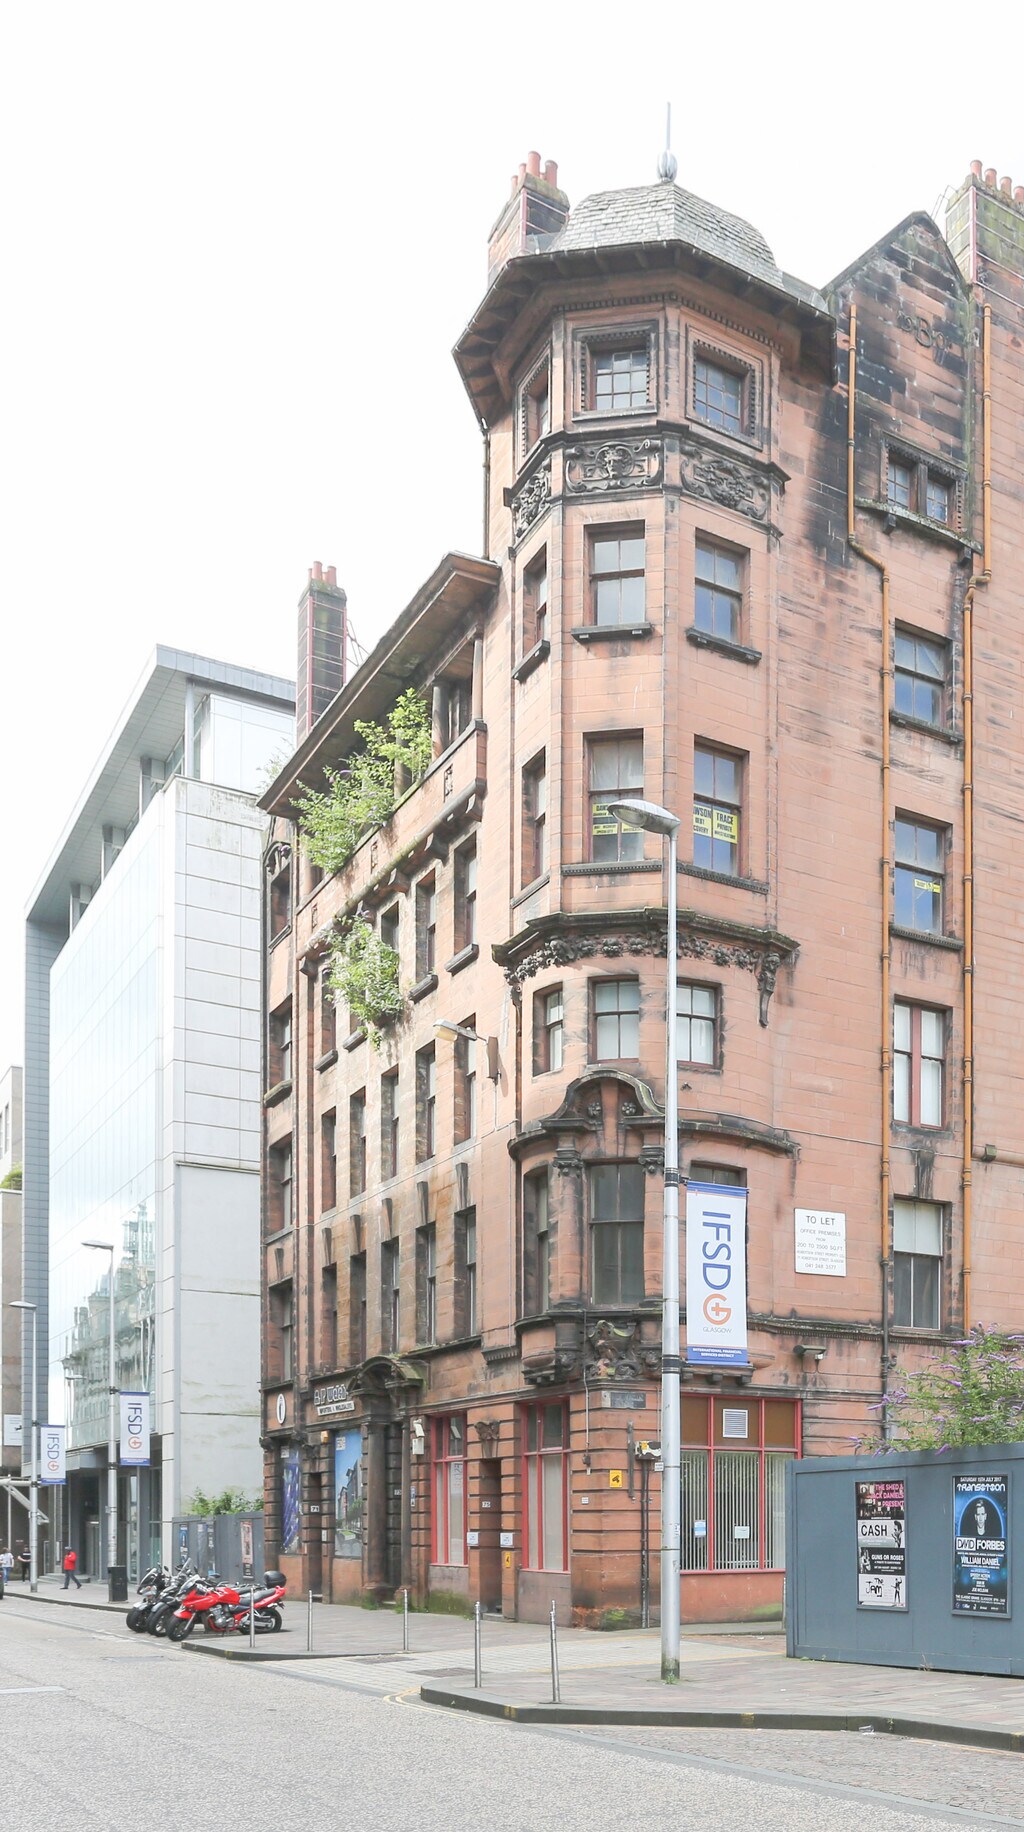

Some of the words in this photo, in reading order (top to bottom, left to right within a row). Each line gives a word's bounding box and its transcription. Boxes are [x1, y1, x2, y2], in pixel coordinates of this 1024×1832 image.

[716, 812, 734, 825] TRACE
[805, 1215, 817, 1225] TO
[820, 1217, 836, 1226] LET
[702, 1211, 732, 1290] IFSD
[703, 1326, 732, 1334] GLASGOW
[128, 1402, 142, 1435] IFSD
[47, 1433, 59, 1459] IFSD
[875, 1483, 885, 1491] THE
[886, 1483, 899, 1491] SHED
[882, 1500, 904, 1508] PRESENT
[861, 1524, 887, 1537] CASH
[957, 1538, 975, 1550] DAVID
[976, 1539, 1005, 1551] FORBES
[961, 1556, 981, 1565] WILLIAM
[982, 1557, 1000, 1567] DANIEL
